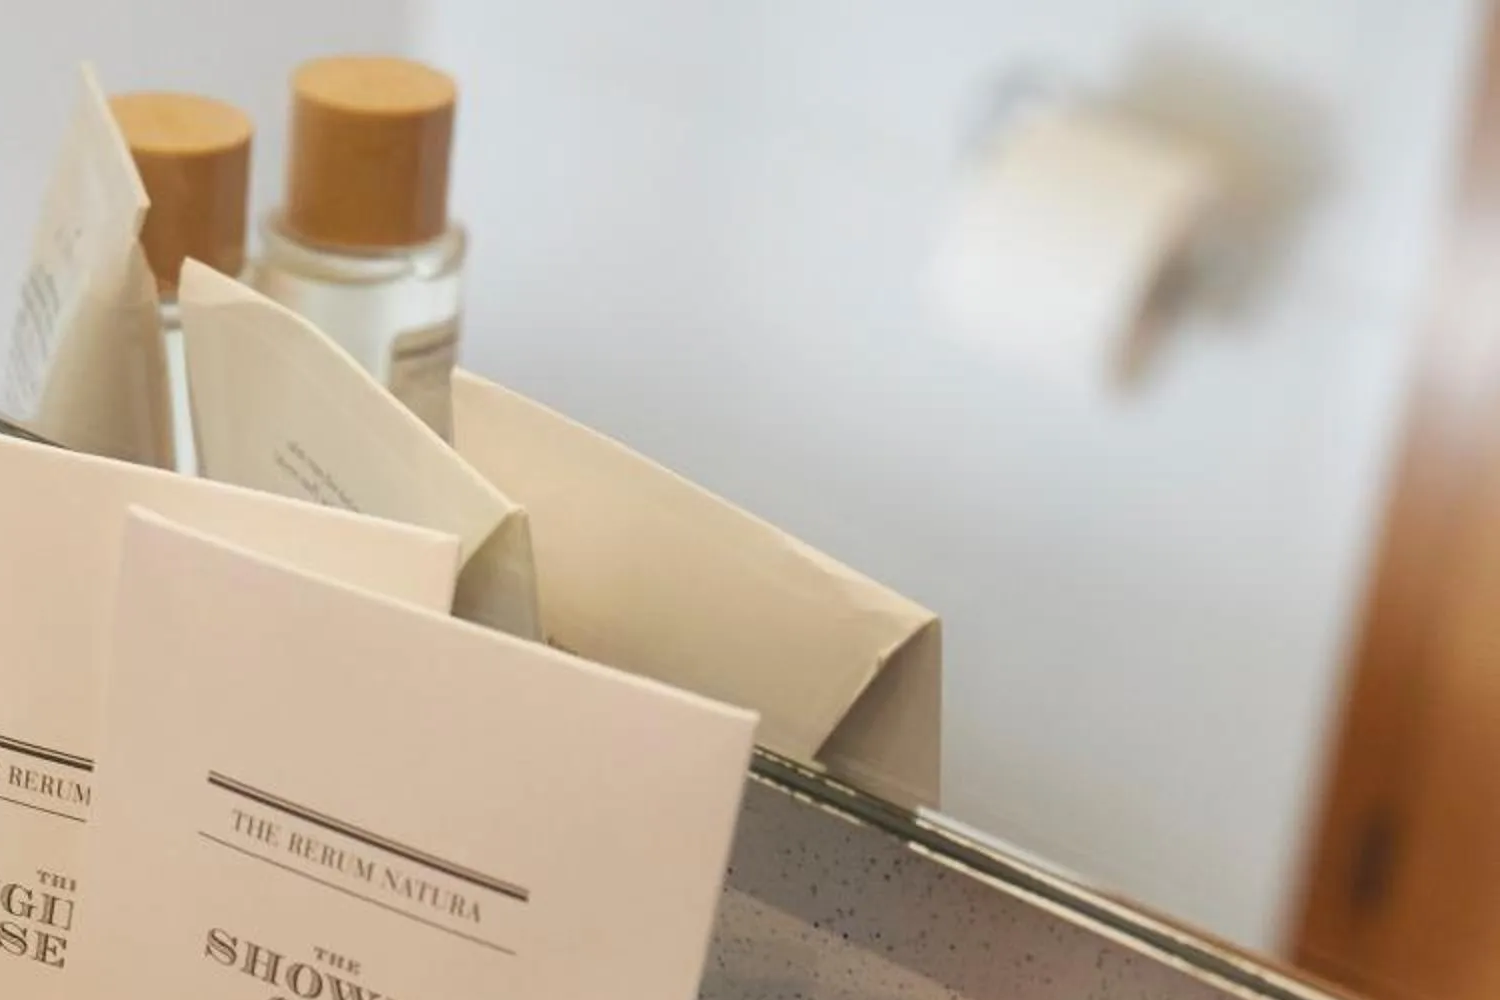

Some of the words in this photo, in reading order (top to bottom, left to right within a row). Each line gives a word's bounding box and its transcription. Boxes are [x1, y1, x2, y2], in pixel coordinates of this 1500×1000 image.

[8, 763, 92, 807] RERUM
[233, 808, 279, 846] THE
[287, 831, 377, 883] RERUM
[381, 867, 482, 924] NATURA
[313, 946, 362, 976] THE
